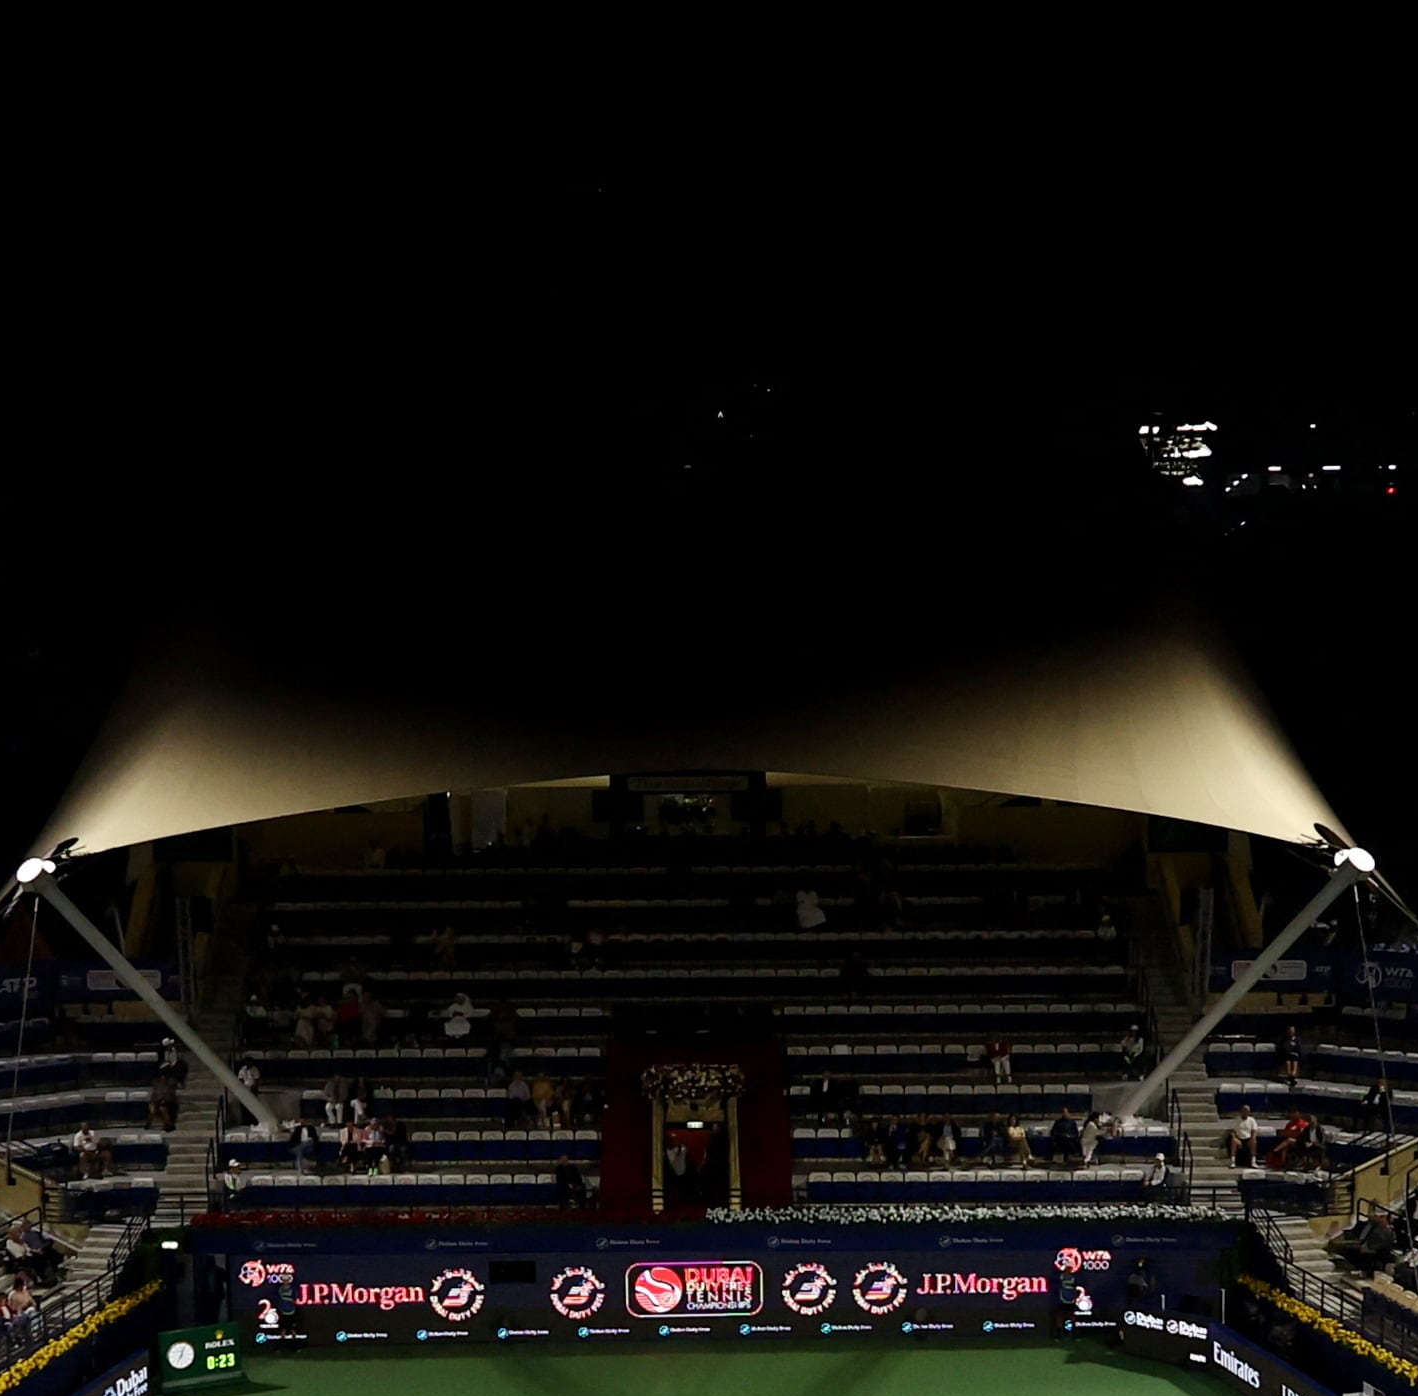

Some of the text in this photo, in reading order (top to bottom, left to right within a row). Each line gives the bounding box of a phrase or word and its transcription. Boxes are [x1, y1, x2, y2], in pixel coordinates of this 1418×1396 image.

[1083, 1251, 1111, 1261] WTA
[1083, 1261, 1109, 1270] 1000
[684, 1266, 754, 1283] DUBAI
[686, 1281, 752, 1292] DUTY FREE
[916, 1273, 1049, 1300] J.P.Morgan
[296, 1283, 425, 1311] J.P.Morgan
[686, 1290, 752, 1303] TENNIS
[206, 1353, 235, 1370] 0:23
[1213, 1341, 1261, 1389] Emirates
[116, 1367, 148, 1396] Dubai
